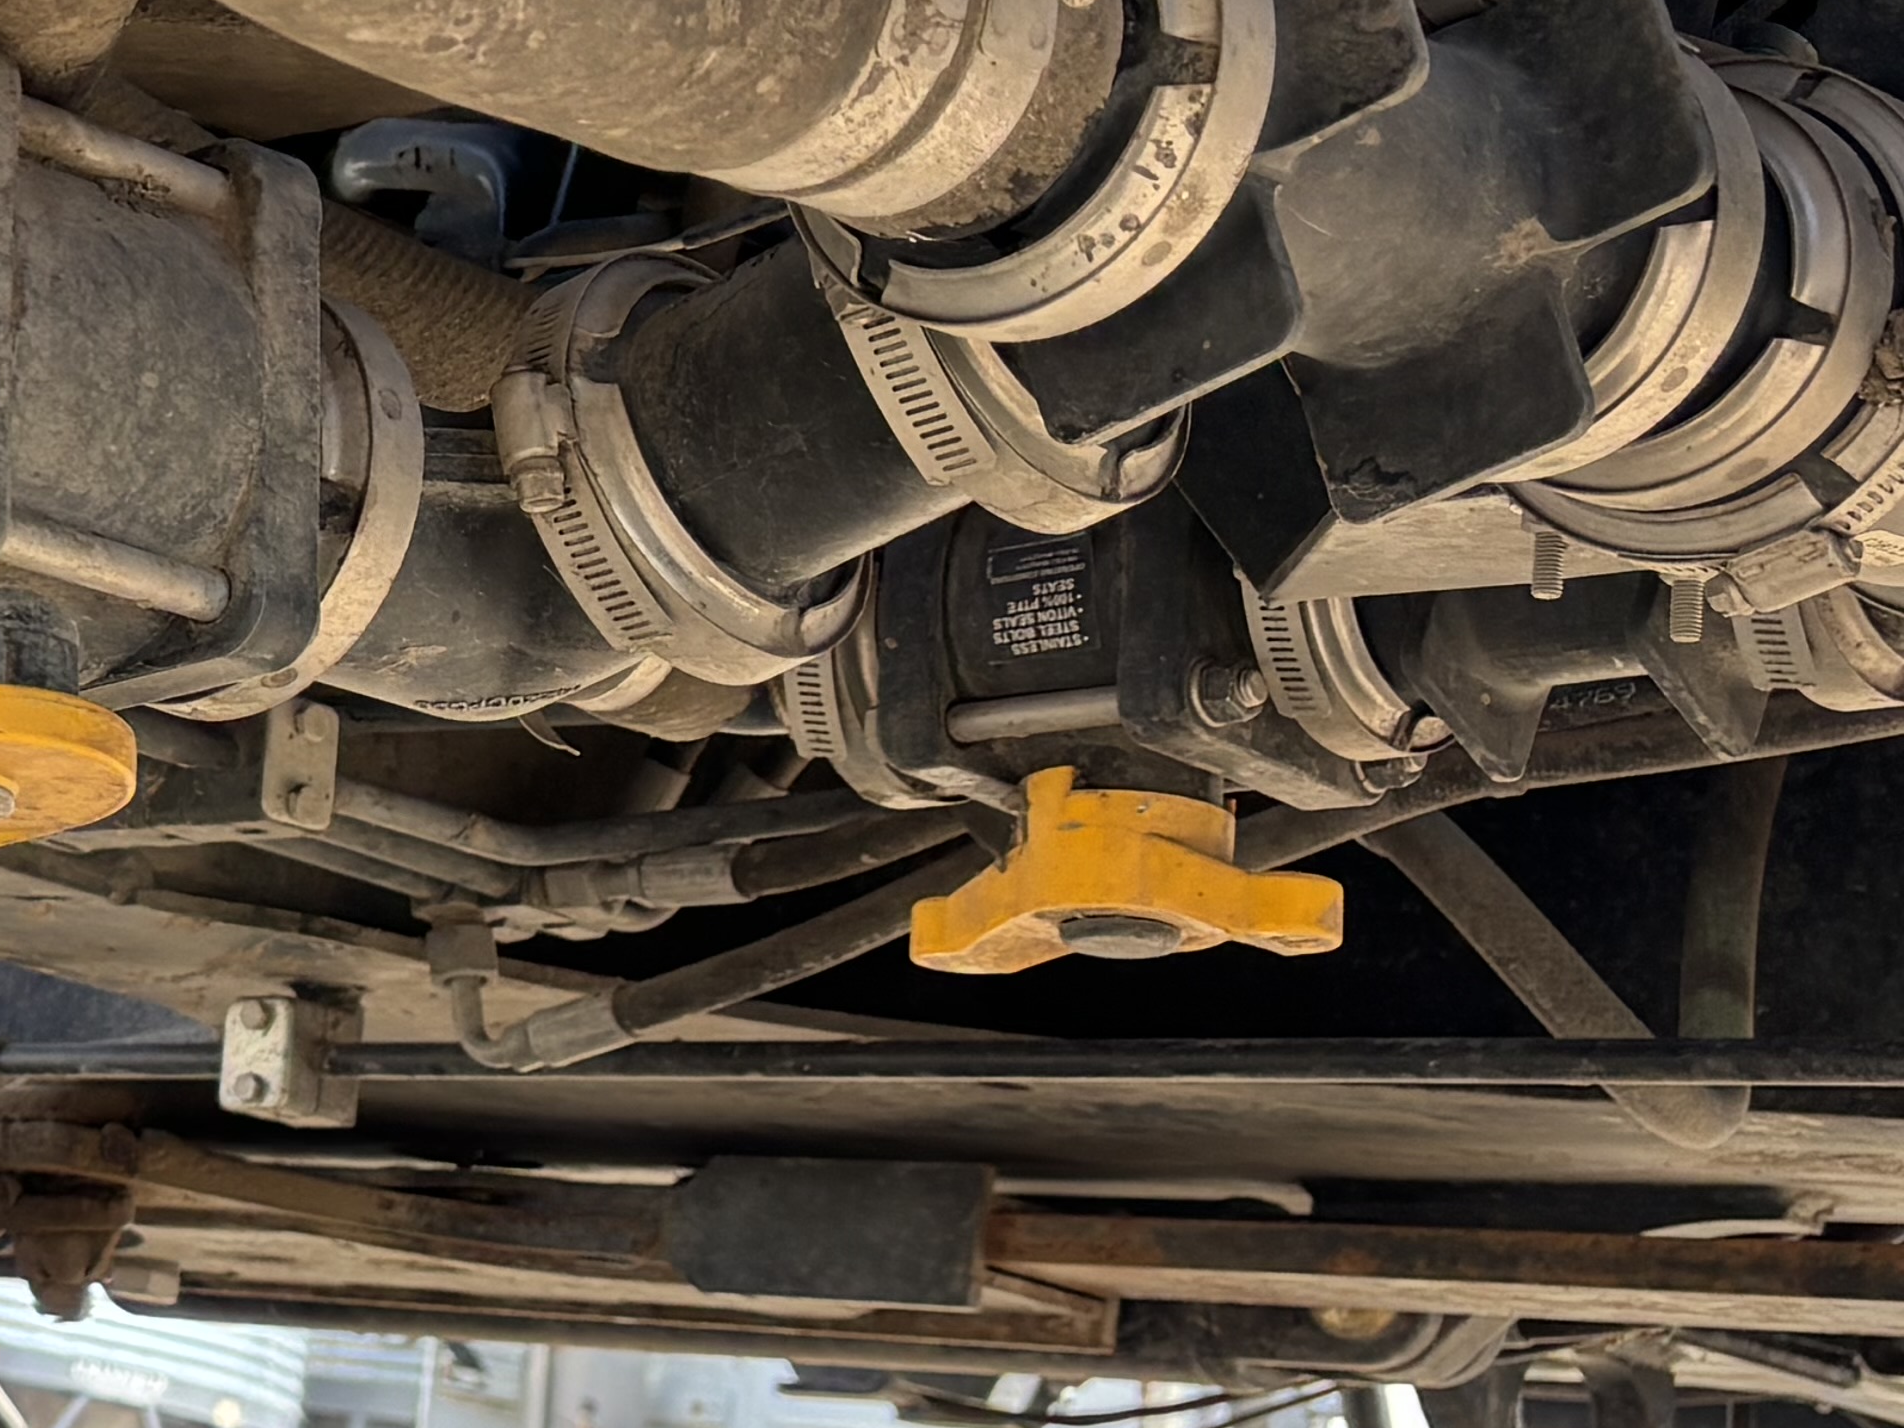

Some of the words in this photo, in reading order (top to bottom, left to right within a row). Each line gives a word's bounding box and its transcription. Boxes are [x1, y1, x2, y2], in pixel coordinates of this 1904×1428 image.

[1032, 578, 1075, 596] SEATS
[992, 612, 1036, 630] SEALS
[1037, 606, 1077, 623] VITON
[993, 627, 1036, 645] BOLTS
[1037, 619, 1080, 637] STEEL
[1011, 633, 1083, 656] STAINLESS
